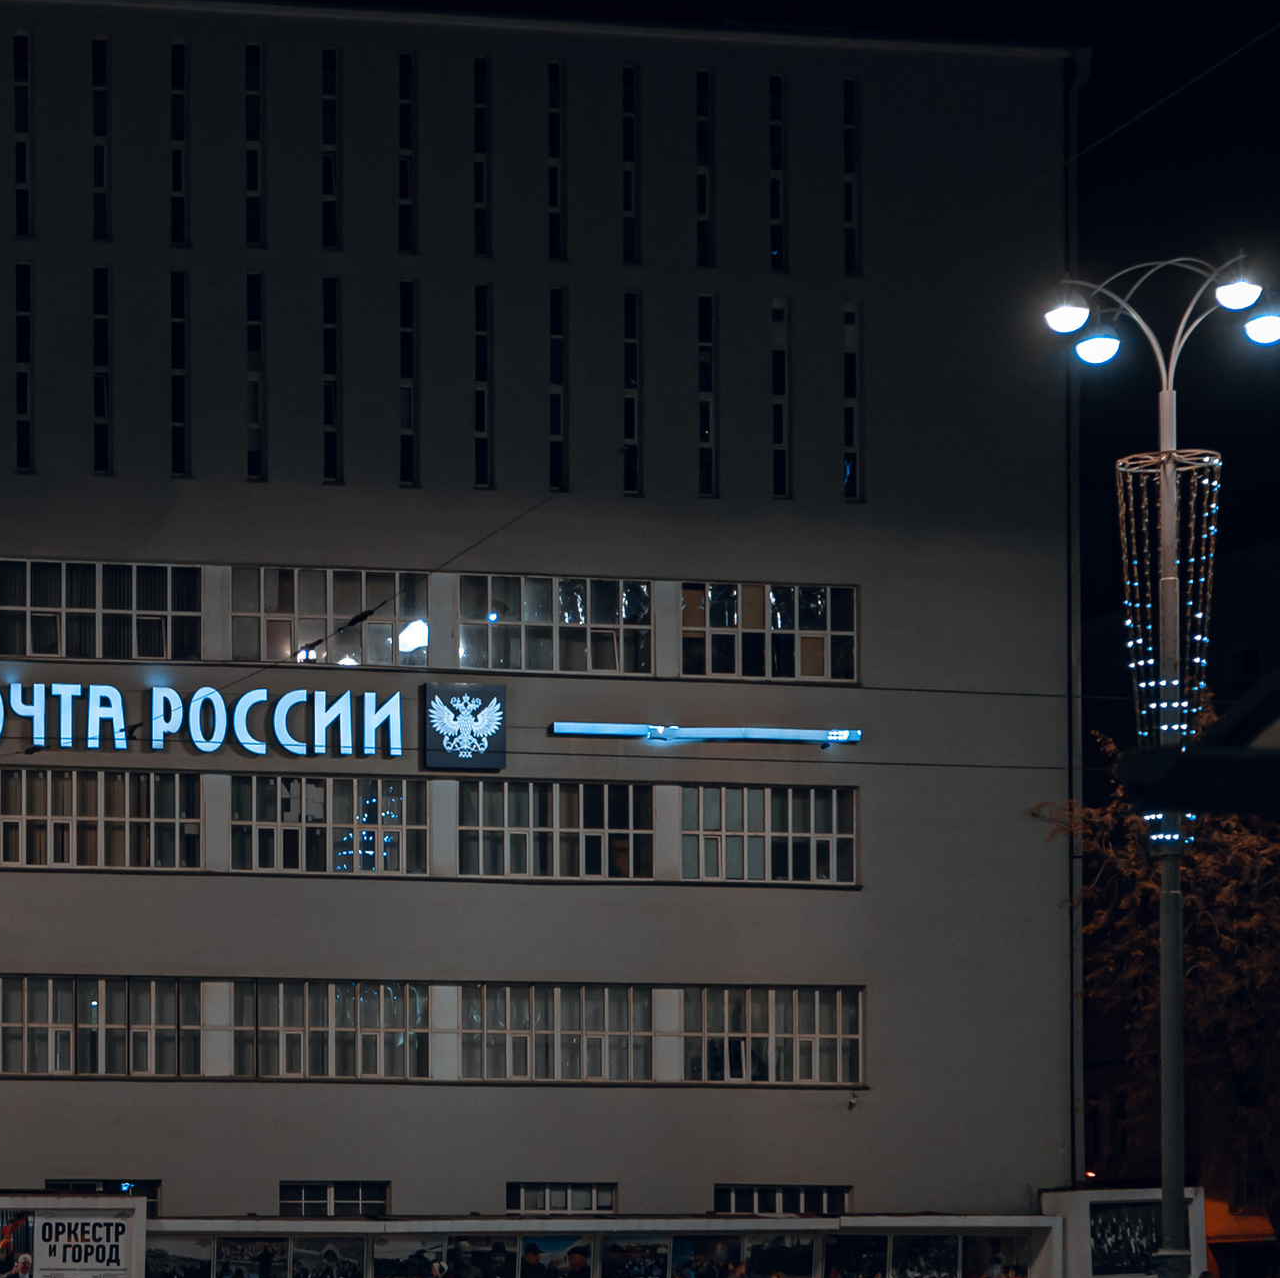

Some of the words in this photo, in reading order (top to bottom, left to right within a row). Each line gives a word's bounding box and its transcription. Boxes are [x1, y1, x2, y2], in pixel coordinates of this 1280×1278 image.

[150, 685, 404, 757] РОССИИ
[41, 1222, 126, 1243] ОРКЕСТР
[62, 1244, 121, 1267] ГОРОД
